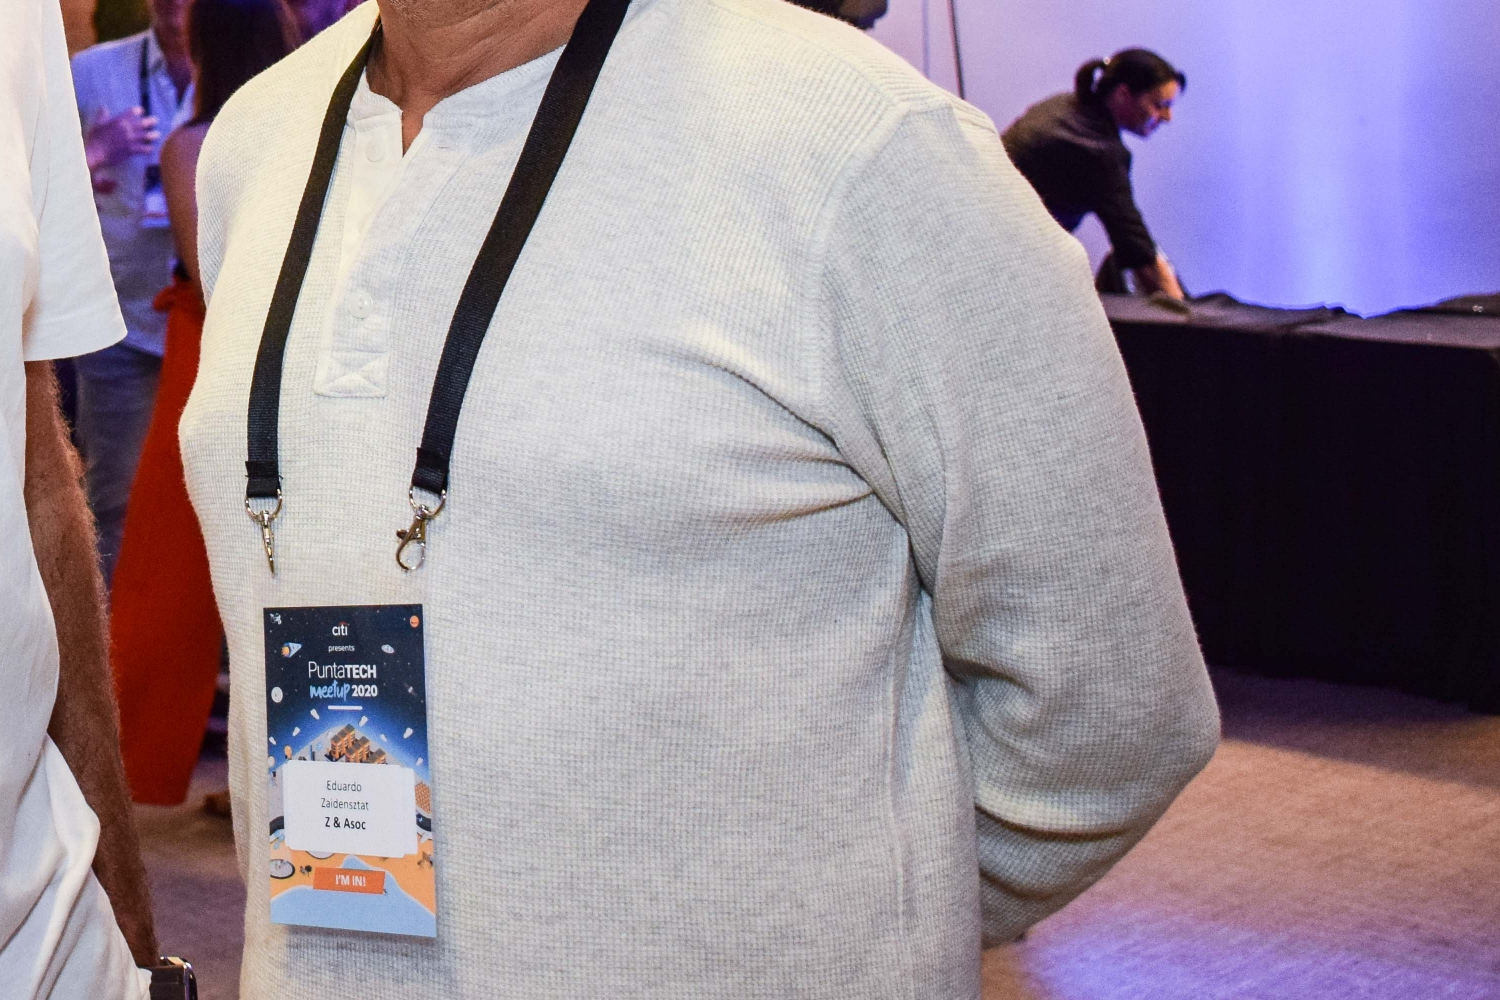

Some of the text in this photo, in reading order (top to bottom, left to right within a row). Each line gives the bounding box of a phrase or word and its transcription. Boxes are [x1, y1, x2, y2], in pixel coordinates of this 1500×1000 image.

[332, 623, 348, 636] citi
[328, 644, 355, 653] presents
[308, 661, 377, 679] PuntaTECH
[351, 684, 378, 697] 2020
[326, 780, 362, 792] Eduardo
[321, 797, 369, 811] Zaidensztat
[325, 816, 366, 830] Z & Asoc
[335, 874, 366, 887] I'M IN!
